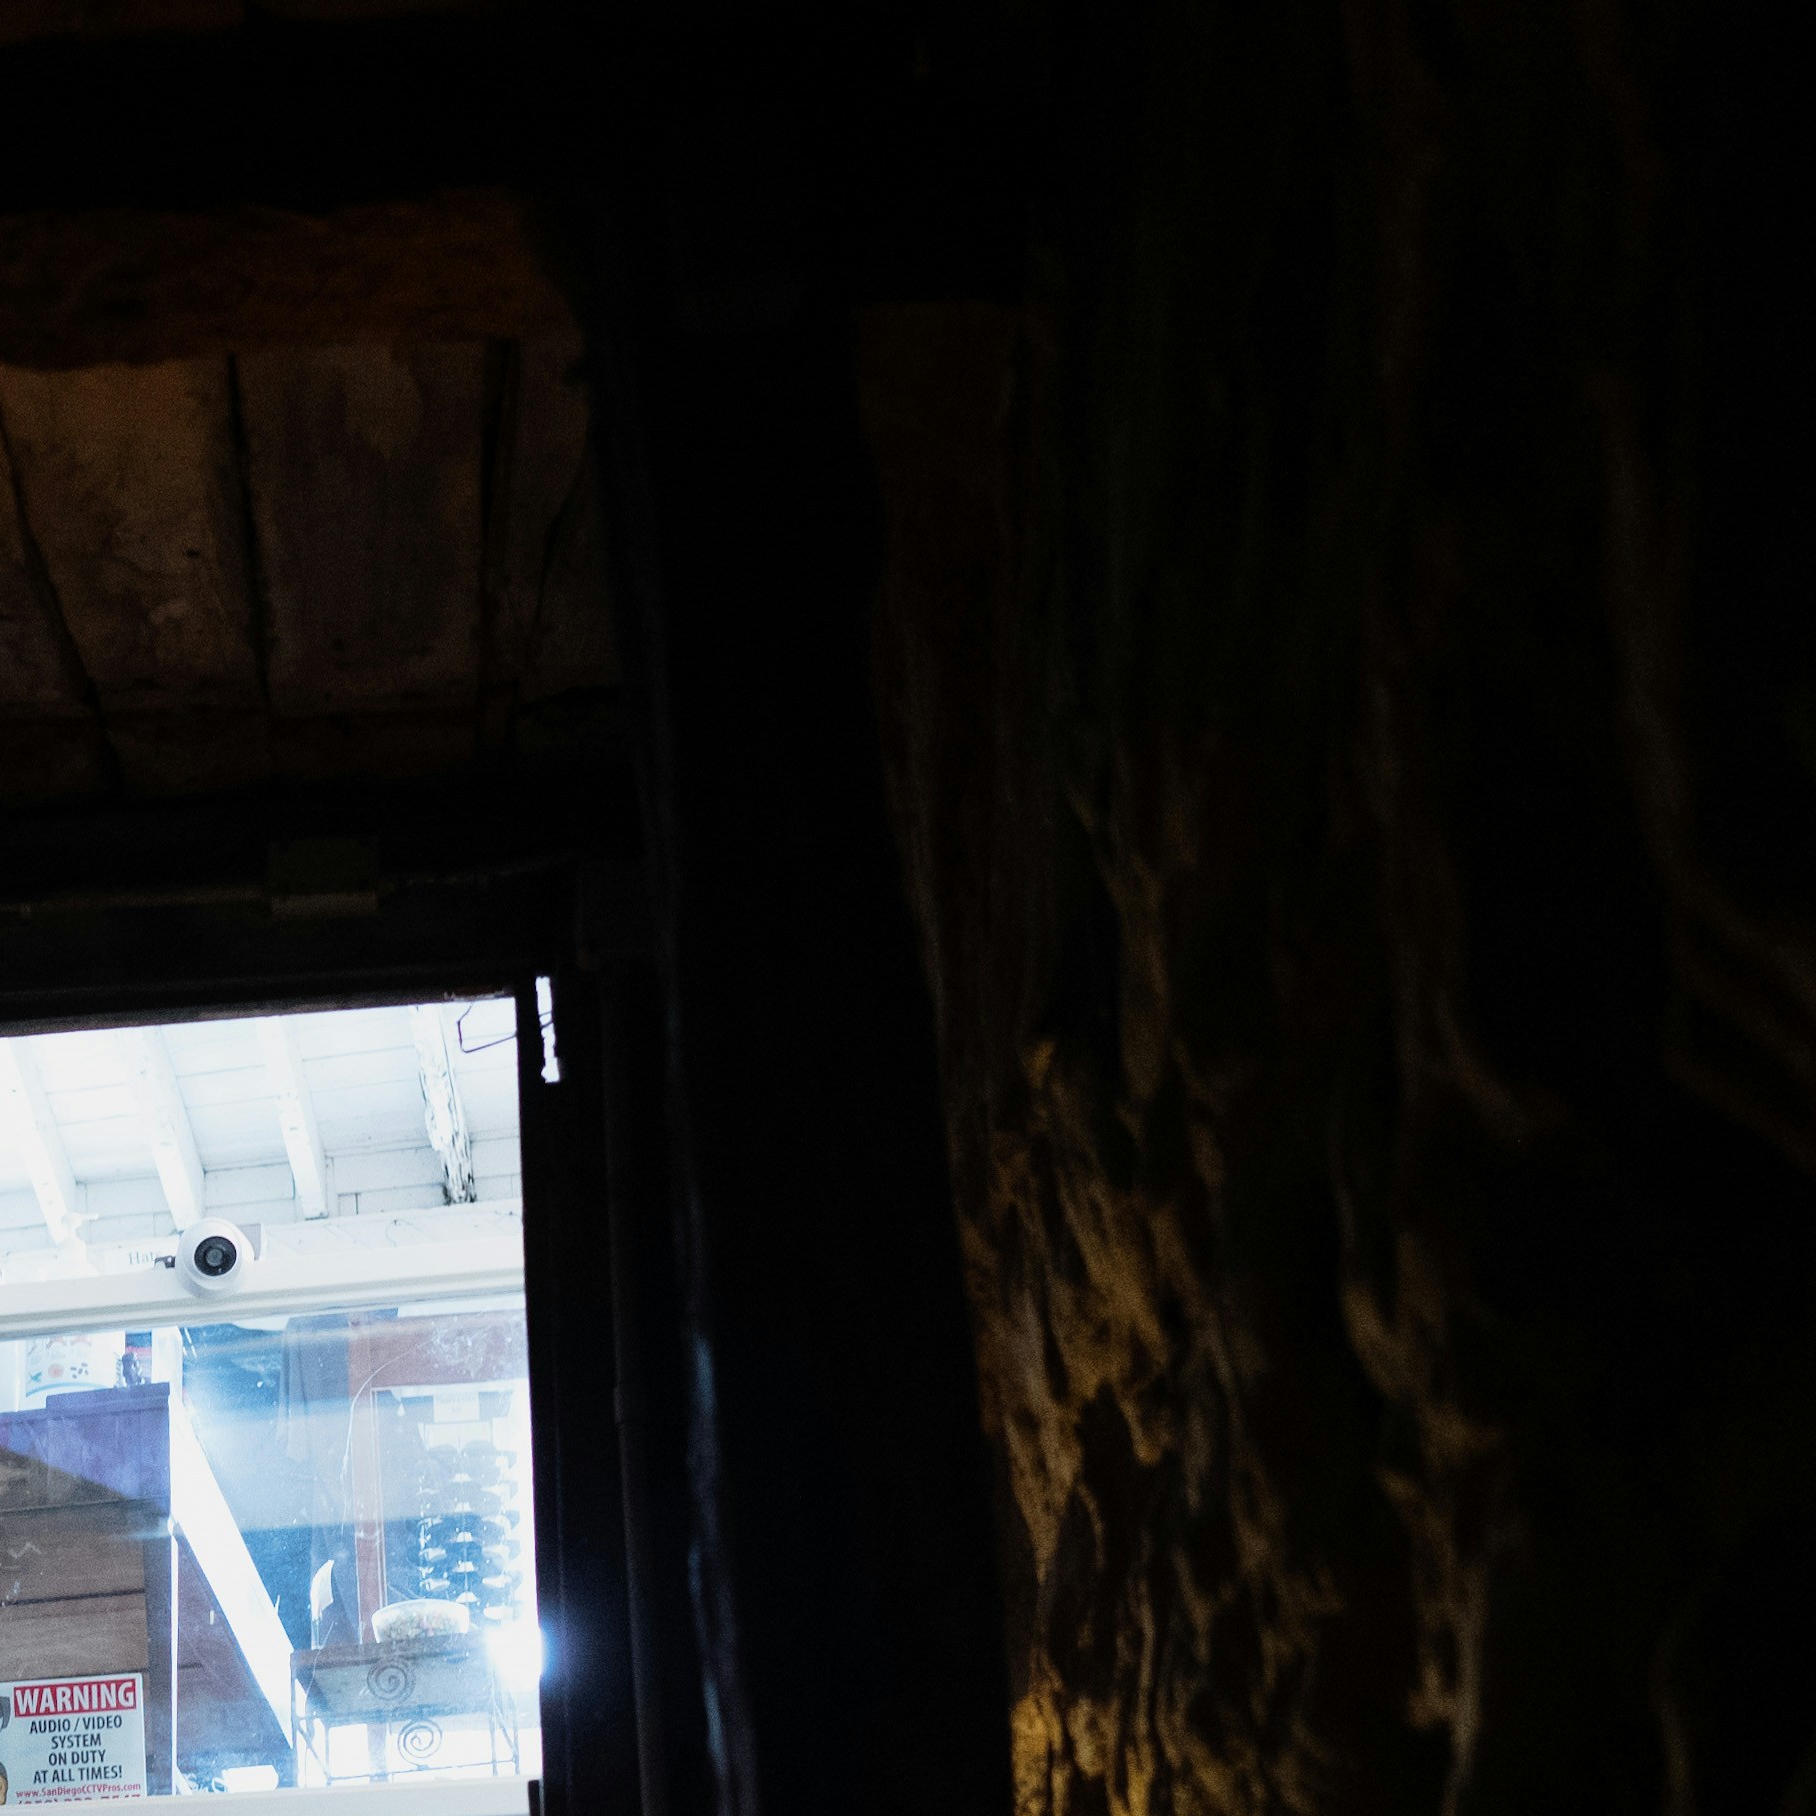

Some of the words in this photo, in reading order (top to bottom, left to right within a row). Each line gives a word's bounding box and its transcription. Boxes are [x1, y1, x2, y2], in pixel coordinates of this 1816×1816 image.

[15, 1681, 135, 1714] WARNING
[30, 1719, 71, 1734] AUDIO
[82, 1715, 122, 1730] VIDEO
[51, 1733, 101, 1749] SYSTEM
[48, 1752, 67, 1766] ON
[72, 1750, 106, 1764] DUTY
[33, 1771, 48, 1784] AT
[51, 1769, 75, 1783] ALL
[77, 1766, 122, 1781] TIMES!
[16, 1784, 141, 1798] www.SanDiegoCCTVPros.com
